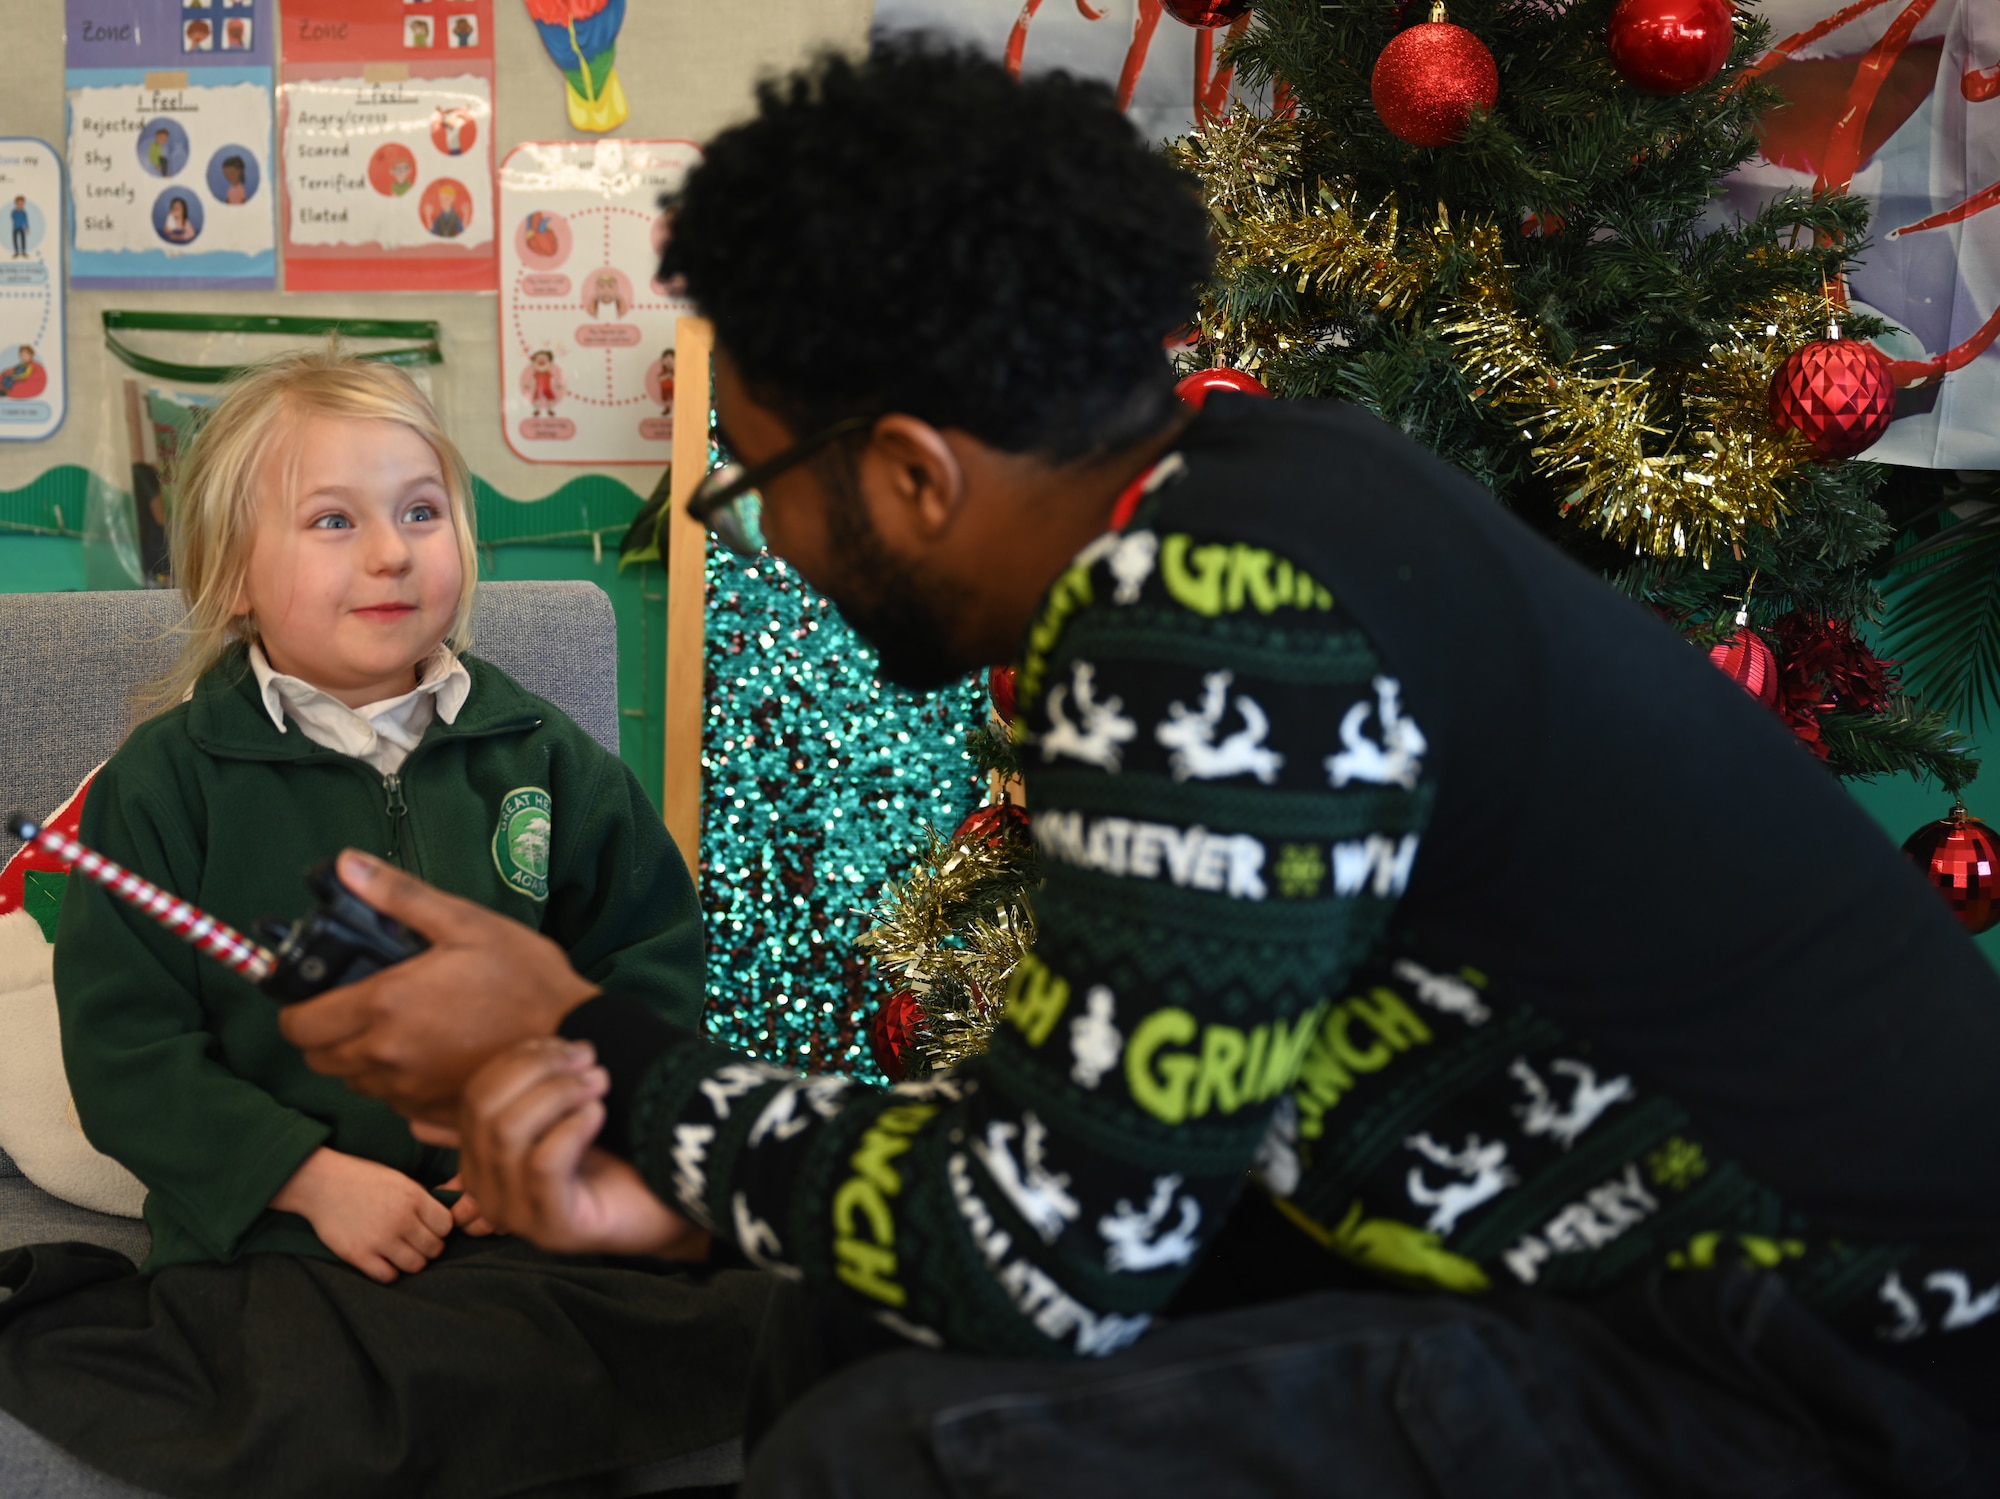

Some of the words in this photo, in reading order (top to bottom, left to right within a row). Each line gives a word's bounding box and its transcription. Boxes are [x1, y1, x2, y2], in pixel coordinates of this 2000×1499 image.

[82, 20, 132, 42] Zone
[299, 18, 348, 42] Zone
[82, 116, 145, 137] Rejected
[299, 144, 350, 157] Scared
[84, 152, 113, 171] Shy
[299, 173, 366, 193] Terrified
[86, 183, 136, 205] Lonely
[84, 215, 114, 230] Sick
[300, 207, 349, 223] Elated
[501, 794, 531, 832] GREAT
[1503, 1162, 1658, 1284] MERRY
